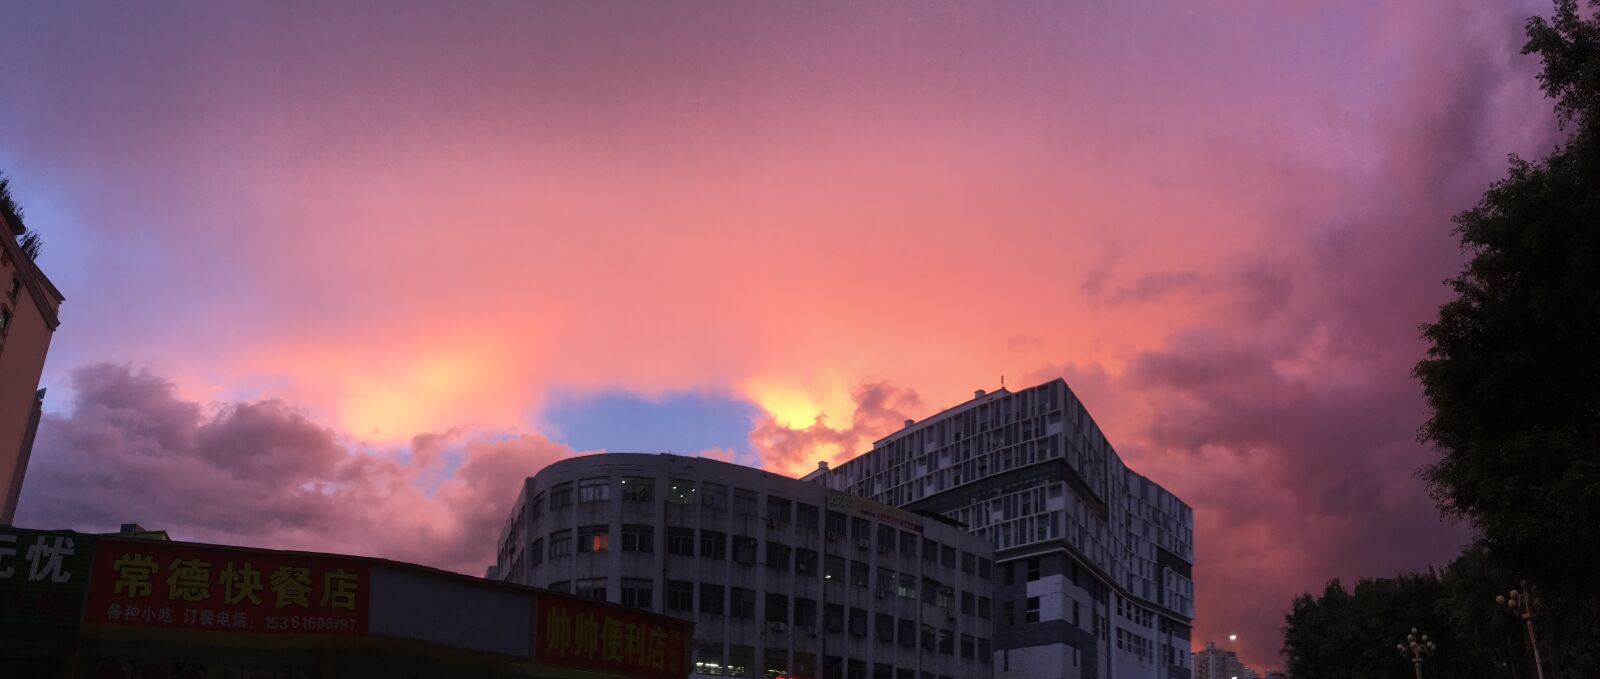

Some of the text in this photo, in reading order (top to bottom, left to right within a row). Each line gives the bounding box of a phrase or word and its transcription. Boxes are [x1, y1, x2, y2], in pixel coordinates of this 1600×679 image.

[113, 553, 358, 610] 常德快餐店
[107, 602, 174, 624] 各种小吃
[545, 607, 668, 671] 帅帅便利店
